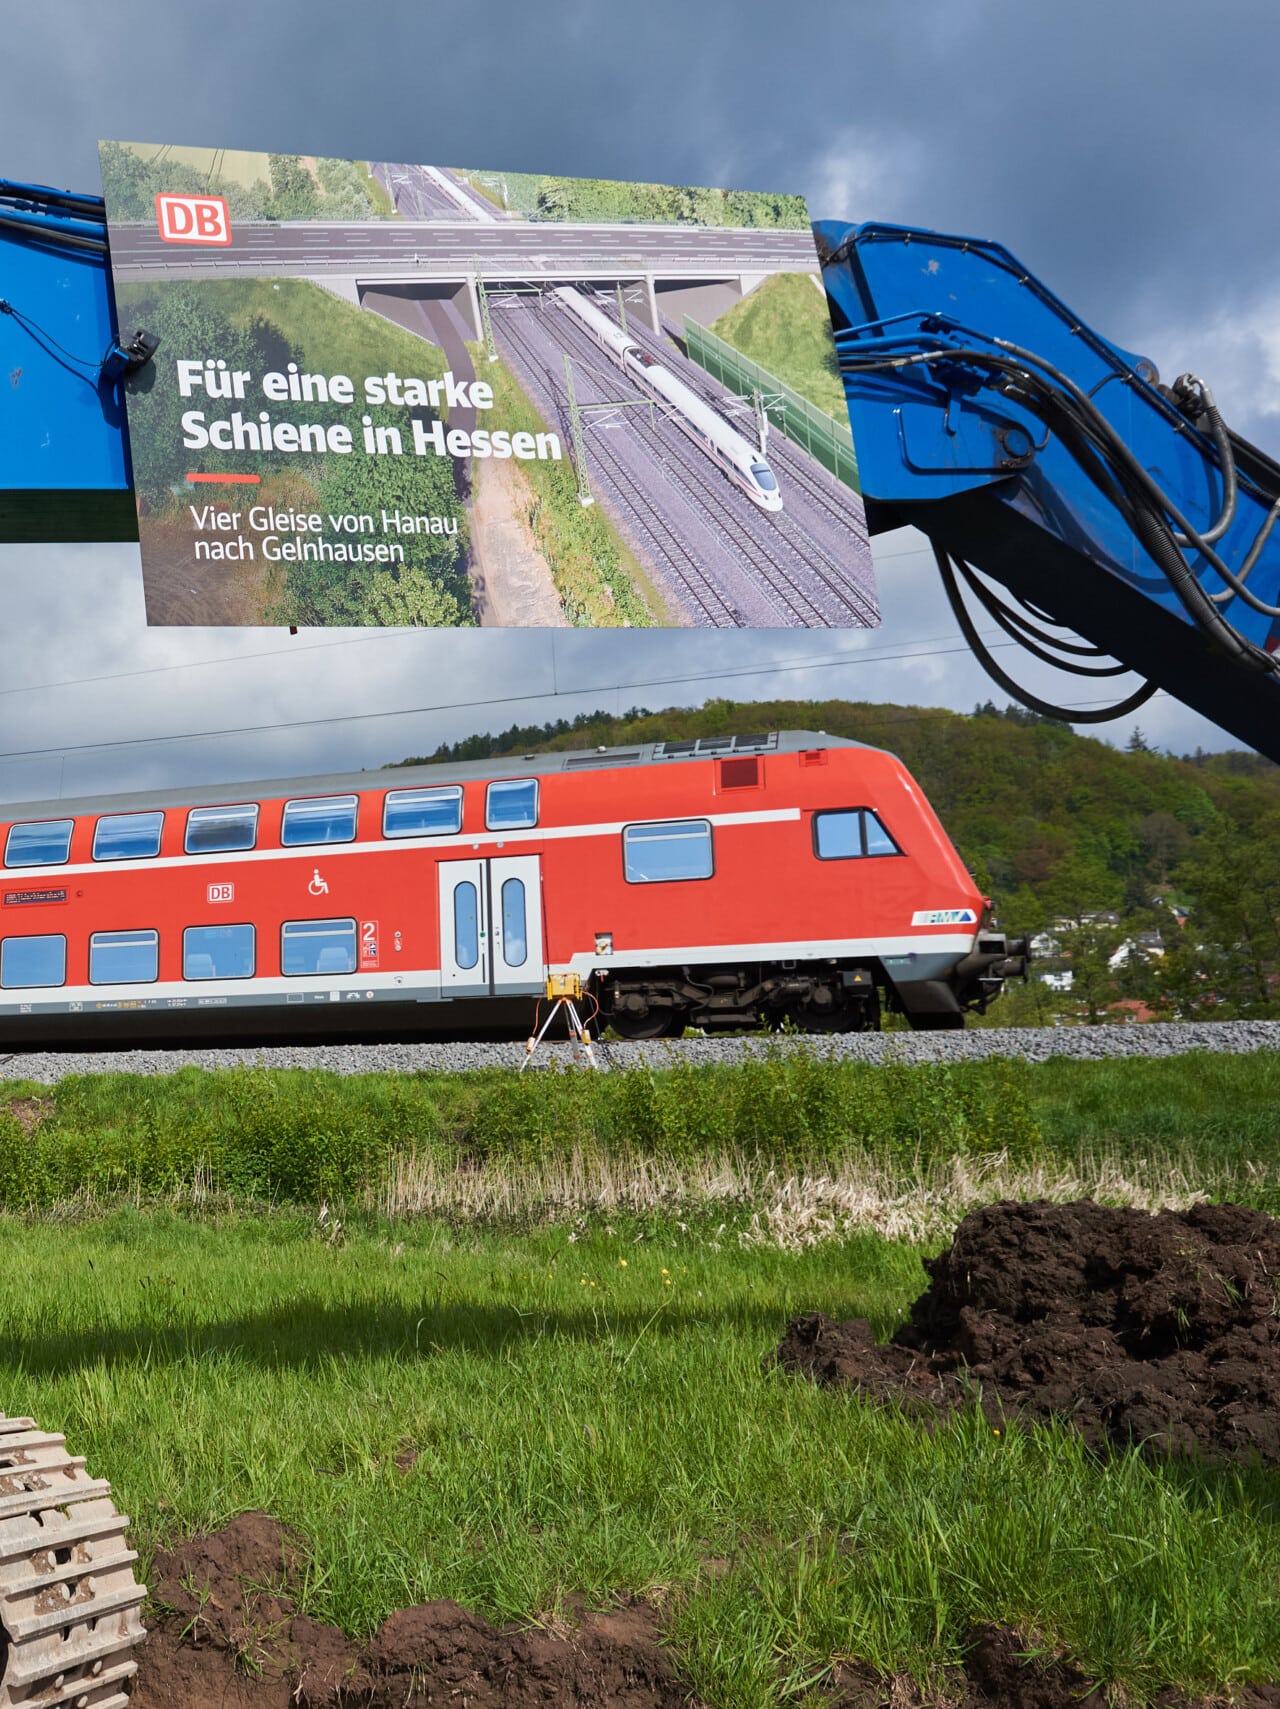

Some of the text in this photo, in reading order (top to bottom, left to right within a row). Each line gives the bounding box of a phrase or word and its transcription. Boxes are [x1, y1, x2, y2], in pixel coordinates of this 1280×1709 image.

[166, 202, 222, 237] DB
[176, 359, 494, 409] Für eine starke
[181, 410, 562, 460] Schiene in Hessen
[189, 505, 459, 535] Vier Gleise von Hanau
[194, 536, 405, 563] nach Gelnhausen
[211, 886, 231, 900] DB
[363, 922, 376, 941] 2
